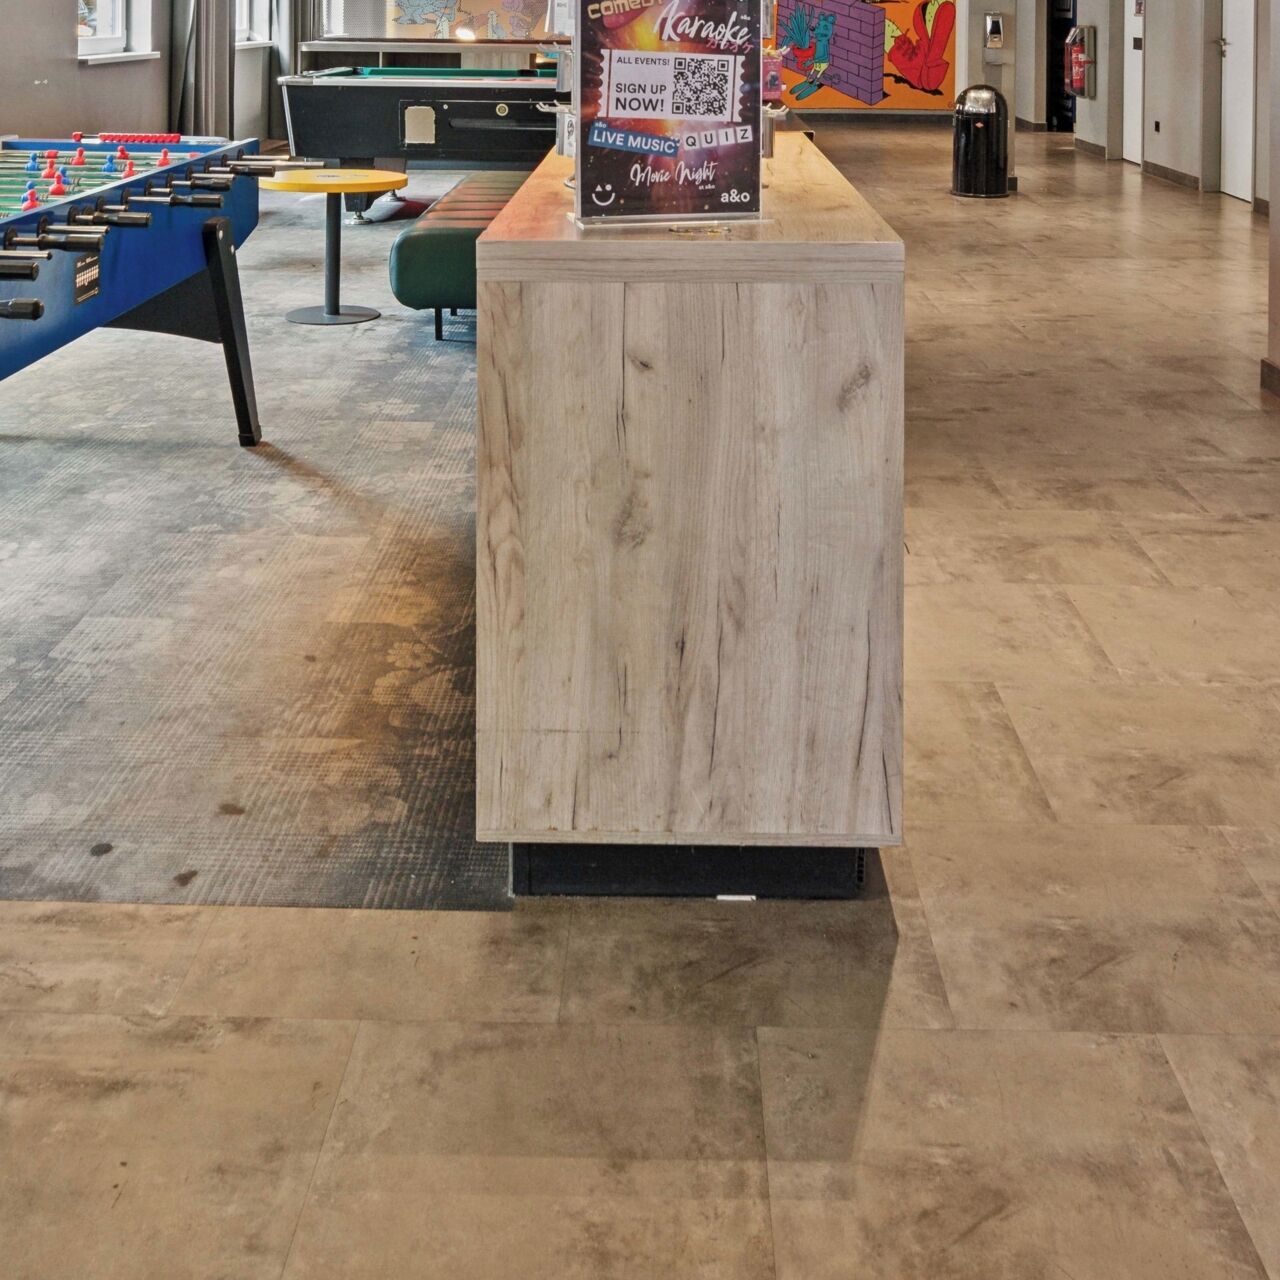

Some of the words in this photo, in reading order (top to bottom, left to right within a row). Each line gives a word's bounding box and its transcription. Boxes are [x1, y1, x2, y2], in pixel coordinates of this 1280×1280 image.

[616, 56, 632, 65] ALL
[634, 57, 670, 66] EVENTS!
[615, 83, 647, 95] SIGN
[650, 84, 667, 95] UP
[615, 97, 665, 112] NOW!
[593, 130, 624, 146] LIVE
[627, 135, 676, 154] MUSIC
[685, 128, 749, 148] QUIZ
[630, 163, 671, 187] Movie
[675, 160, 719, 185] Night
[720, 189, 751, 203] a&o
